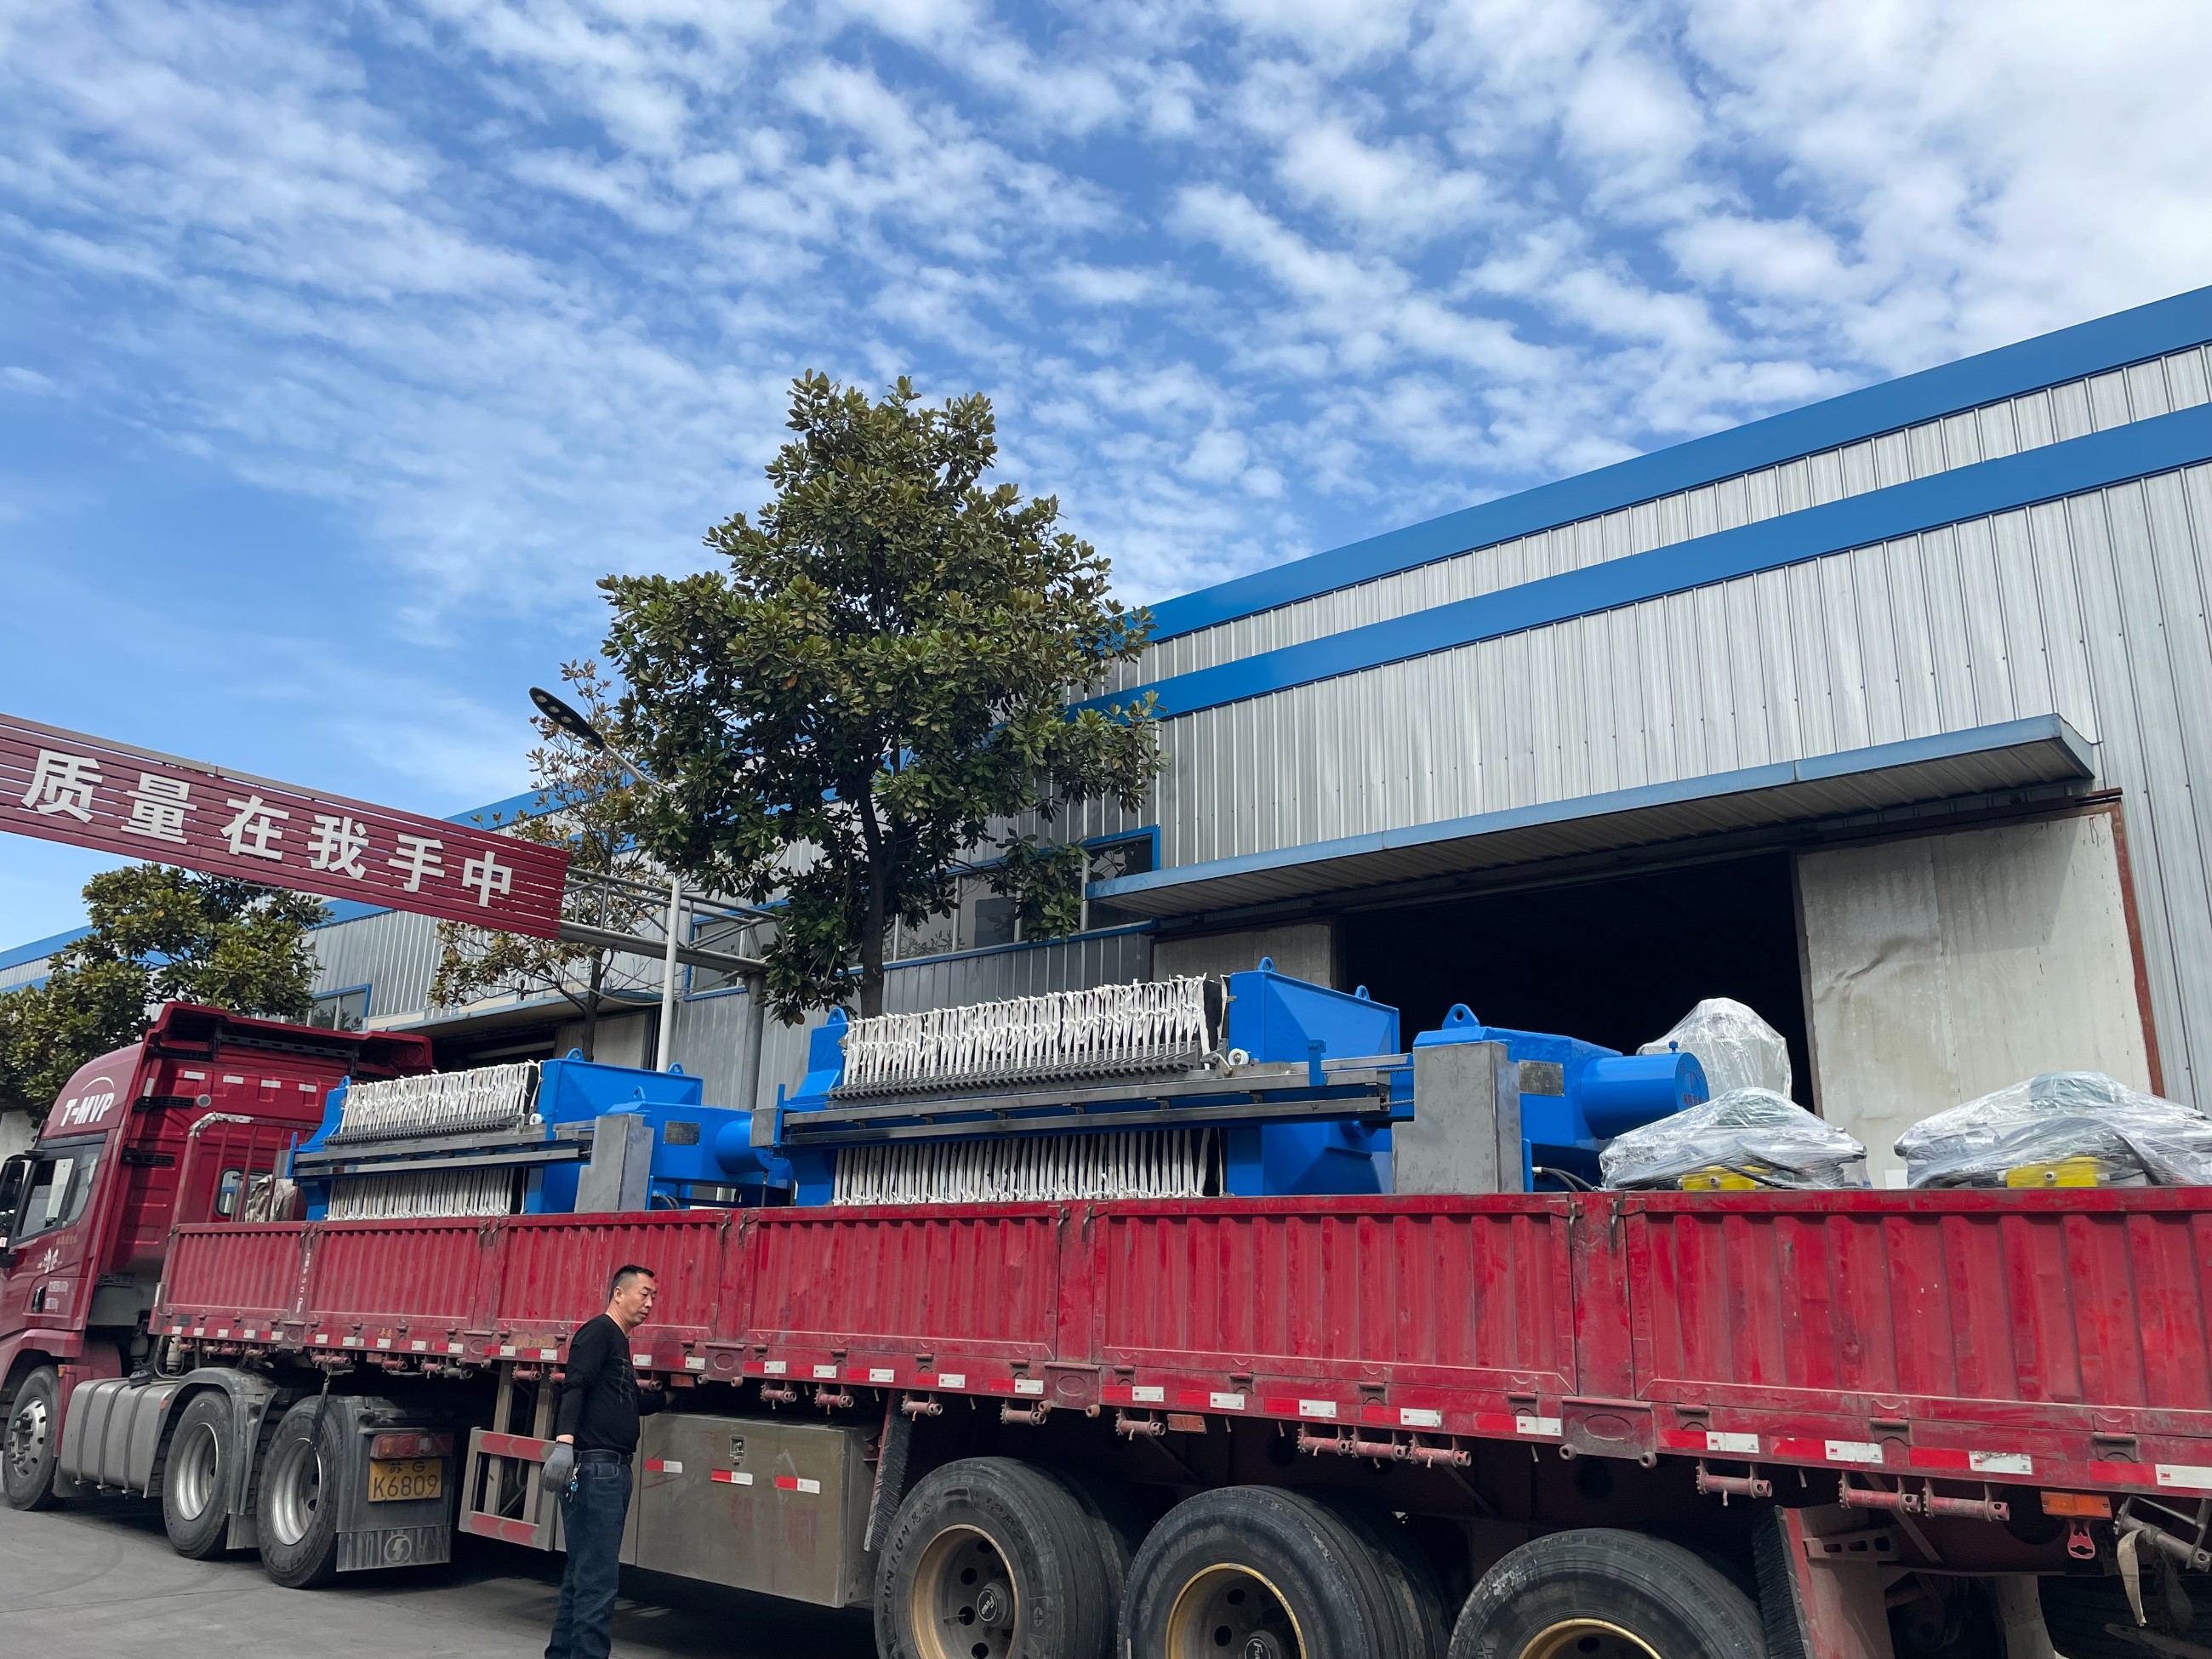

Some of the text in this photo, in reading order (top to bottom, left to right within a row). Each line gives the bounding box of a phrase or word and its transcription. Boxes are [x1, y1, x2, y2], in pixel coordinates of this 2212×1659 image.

[20, 749, 513, 908] 质量在我手中
[60, 1092, 115, 1127] T-MVP
[373, 1474, 437, 1499] K6809
